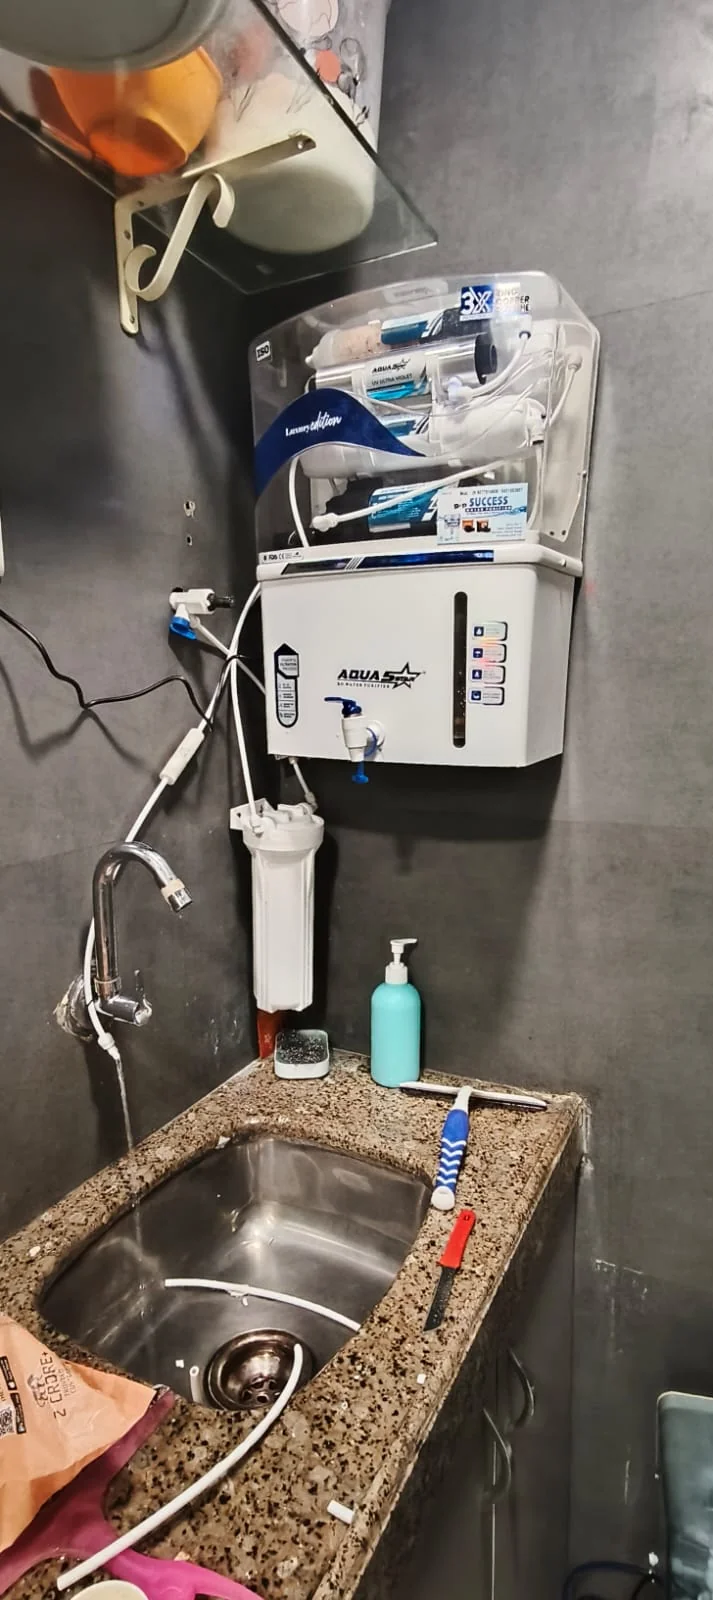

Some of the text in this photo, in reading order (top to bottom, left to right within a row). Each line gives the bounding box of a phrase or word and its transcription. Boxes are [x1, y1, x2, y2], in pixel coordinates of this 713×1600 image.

[461, 287, 493, 314] 3X
[310, 410, 342, 432] edition
[469, 495, 509, 507] SUCCESS
[337, 669, 380, 681] AQUA
